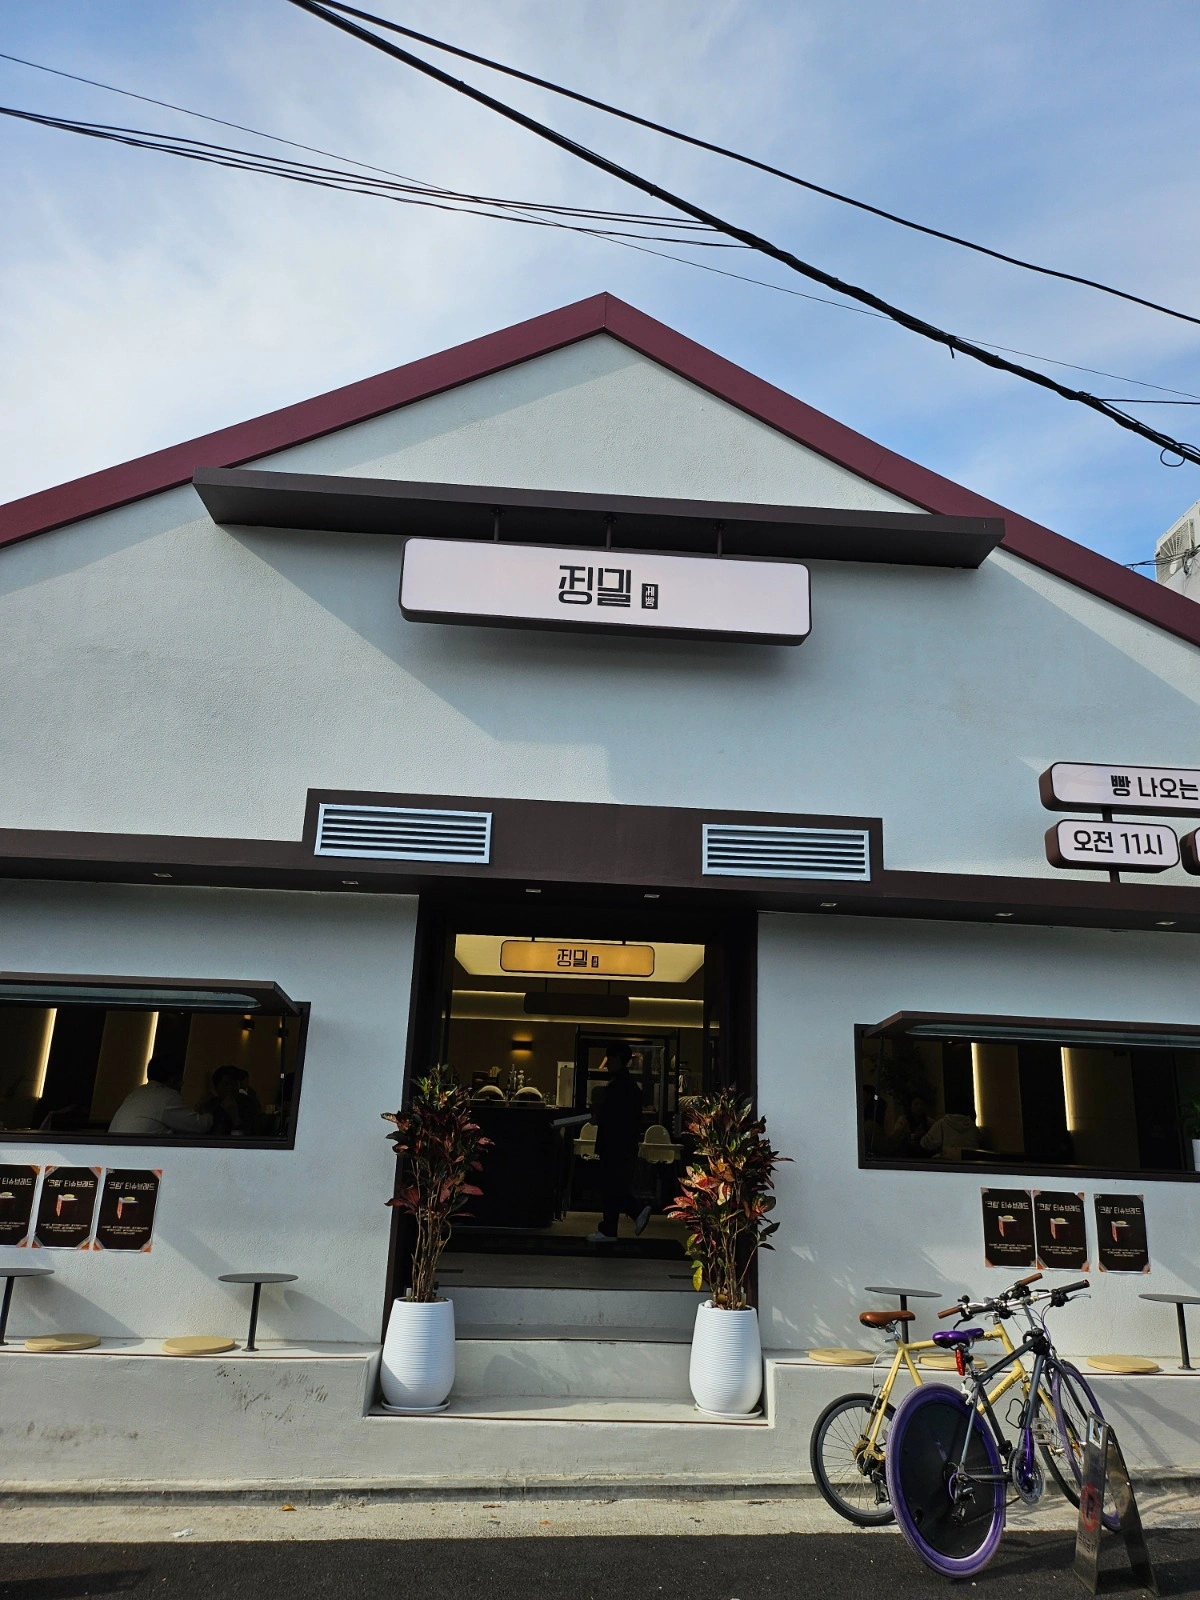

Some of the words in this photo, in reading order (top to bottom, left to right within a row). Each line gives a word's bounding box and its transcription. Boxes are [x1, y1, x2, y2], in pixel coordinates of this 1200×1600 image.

[558, 565, 632, 608] 정밀
[1110, 775, 1131, 797] 빵
[1137, 776, 1199, 801] 나오는
[1073, 829, 1114, 854] 오전
[1120, 832, 1163, 855] 11시
[557, 948, 588, 968] 정밀
